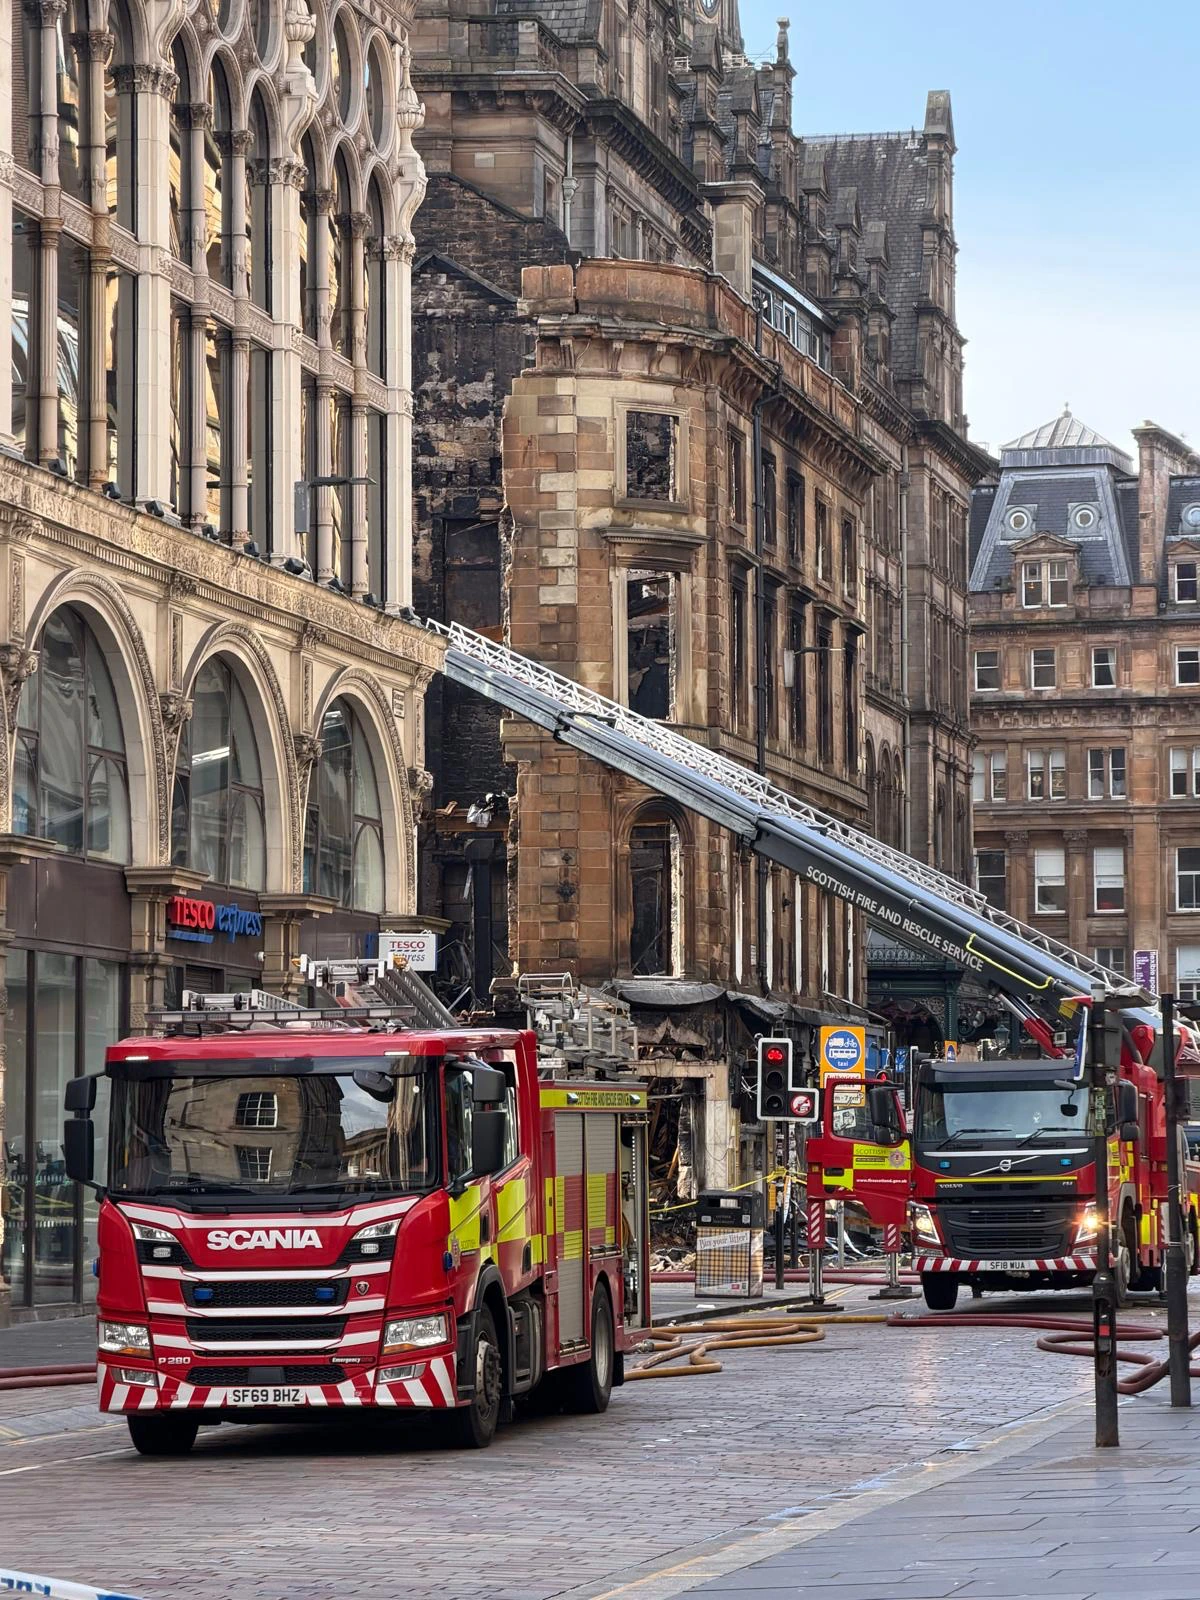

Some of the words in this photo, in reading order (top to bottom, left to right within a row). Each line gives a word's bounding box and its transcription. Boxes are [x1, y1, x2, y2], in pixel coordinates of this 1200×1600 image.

[173, 895, 215, 930] TESCO
[217, 903, 262, 944] express
[806, 865, 856, 901] SCOTTISH
[855, 892, 878, 913] FIRE
[877, 905, 902, 926] AND
[902, 918, 942, 948] RESCUE
[941, 939, 984, 972] SERVICE
[389, 940, 426, 949] TESCO
[206, 1229, 324, 1251] SCANIA
[712, 1238, 727, 1247] your
[990, 1261, 1008, 1270] SF18
[1009, 1261, 1026, 1270] WUA
[158, 1357, 167, 1365] P
[167, 1356, 191, 1365] 280
[232, 1388, 269, 1403] SF69
[272, 1388, 300, 1403] BHZ
